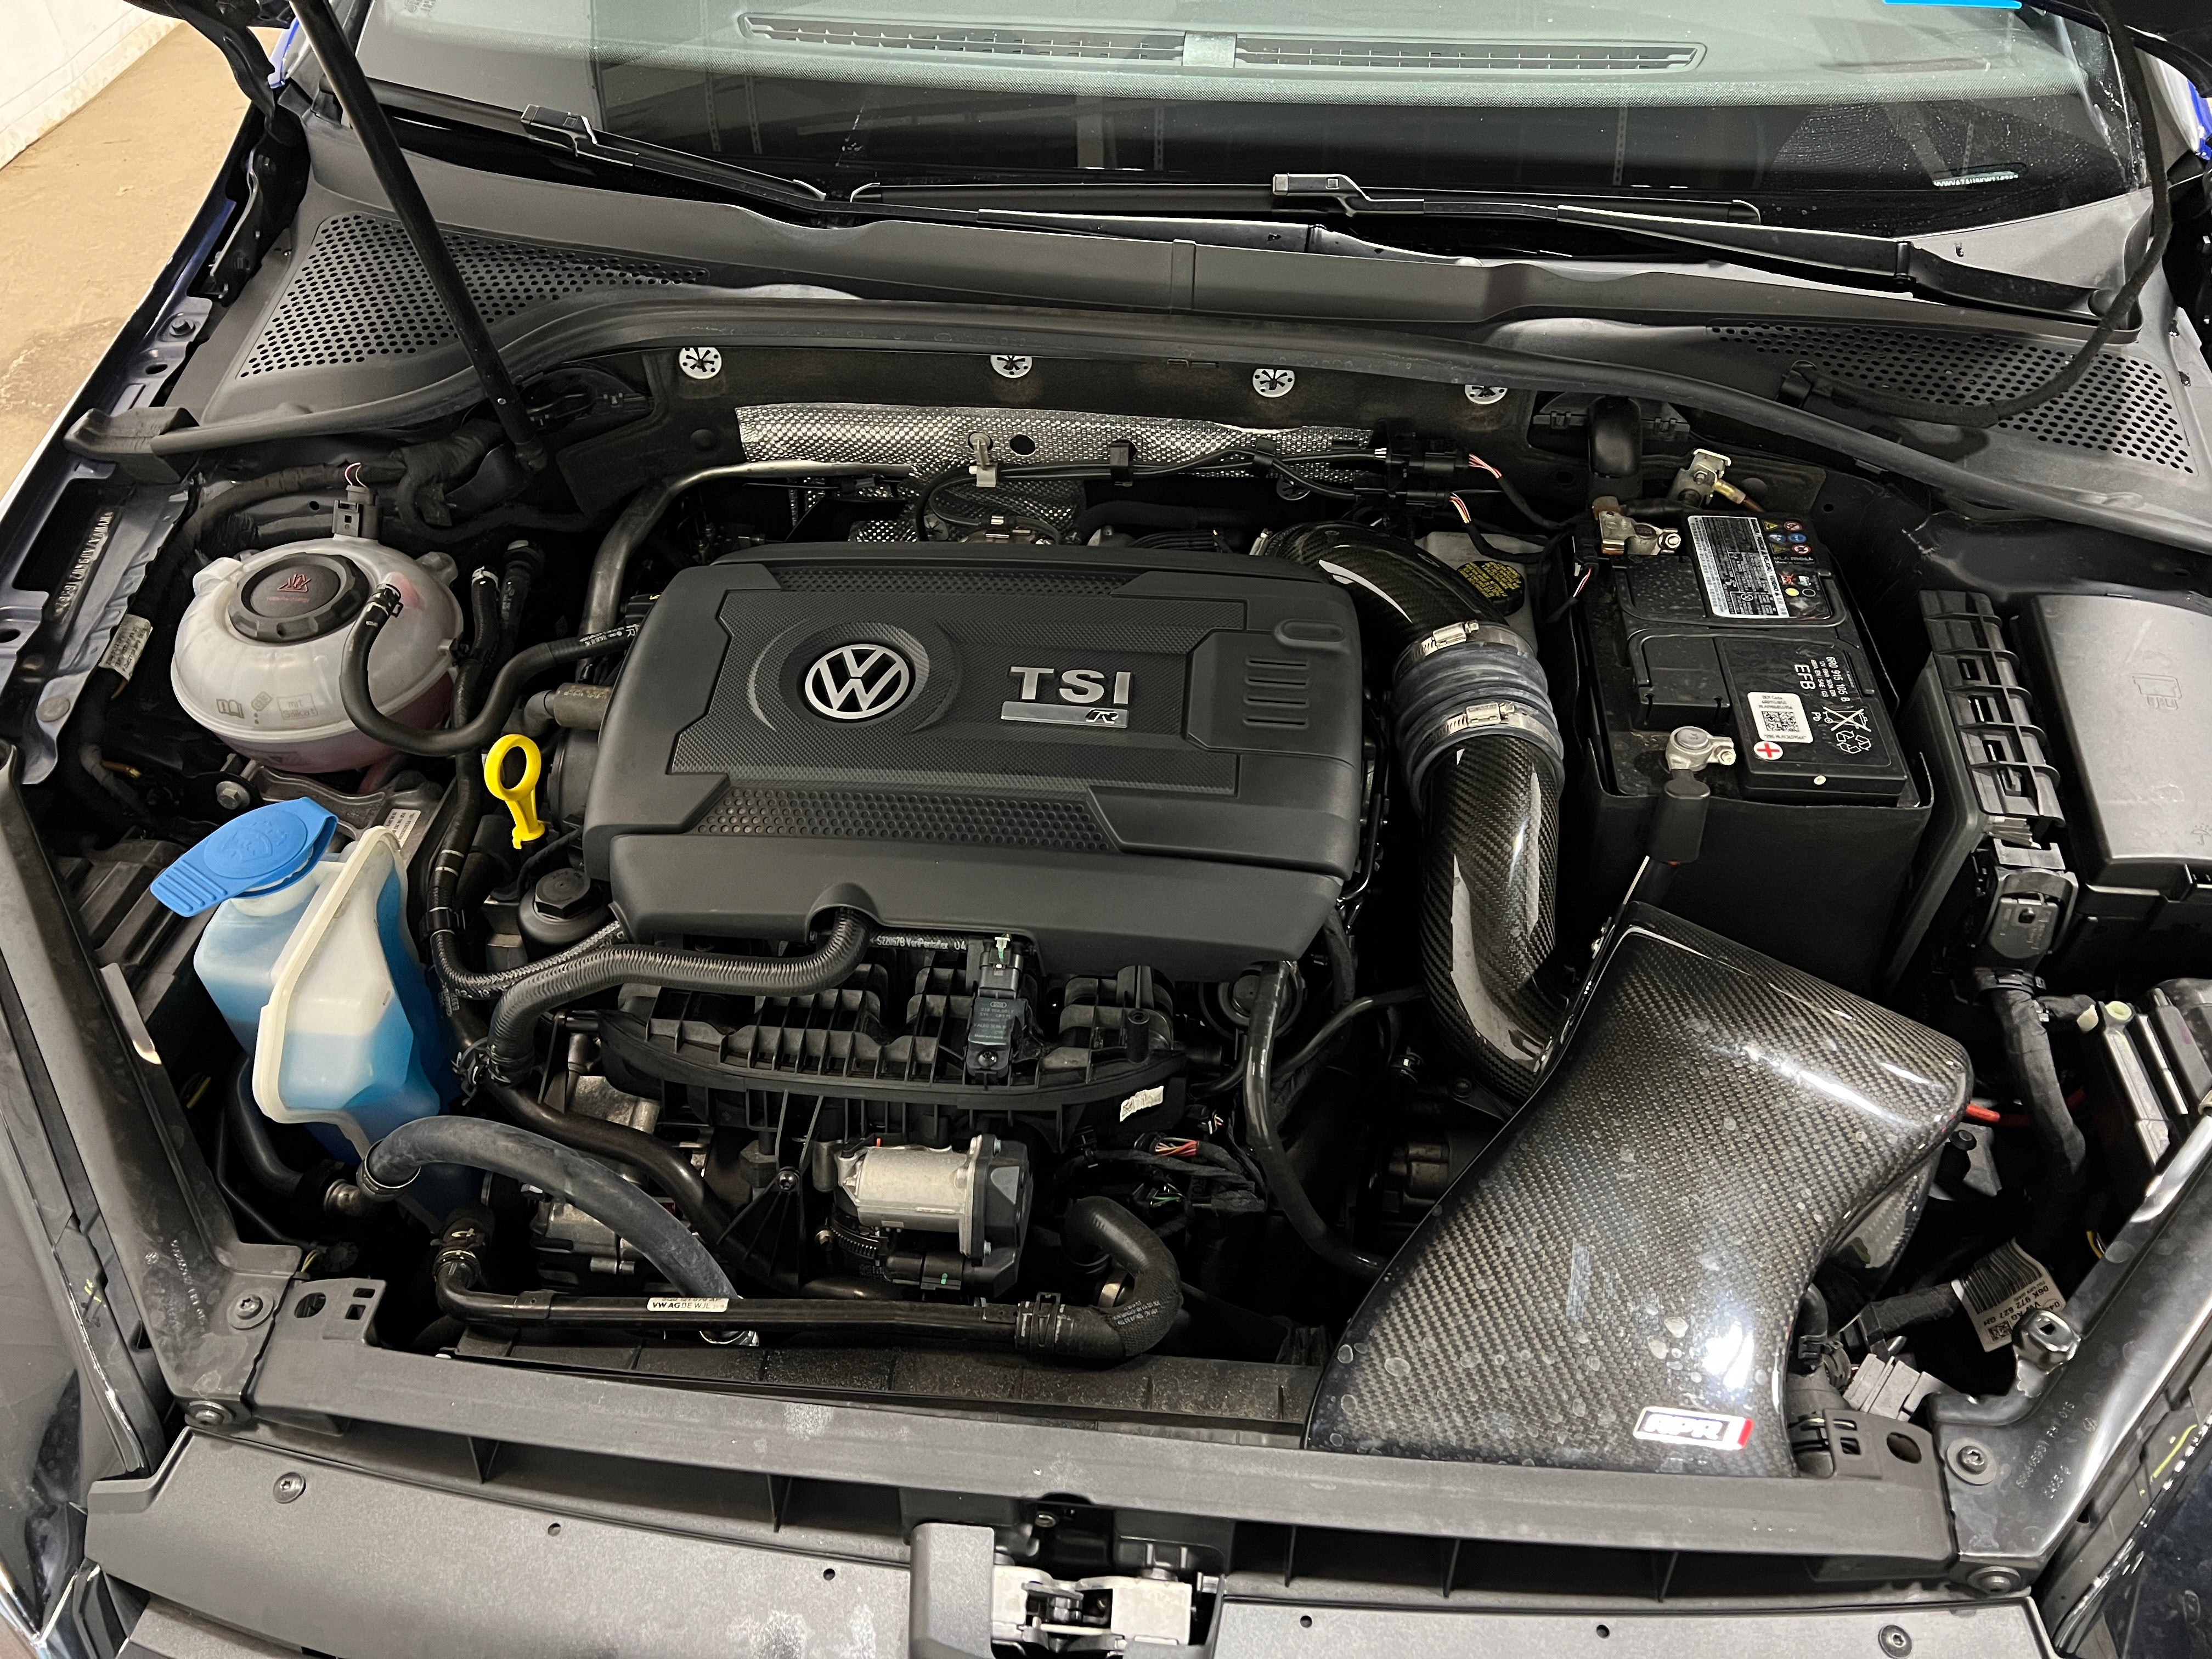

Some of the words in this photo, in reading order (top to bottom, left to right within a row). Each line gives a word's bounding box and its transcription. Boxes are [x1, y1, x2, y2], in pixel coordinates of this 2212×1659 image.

[1826, 656, 1837, 668] 6R0
[1794, 664, 1816, 690] EFB
[1831, 669, 1843, 681] 915
[1009, 665, 1132, 705] TSI
[1836, 682, 1848, 695] 105
[1811, 711, 1822, 721] Pb
[2032, 1285, 2049, 1299] 06K
[2015, 1296, 2031, 1309] 972
[1999, 1306, 2014, 1318] 627
